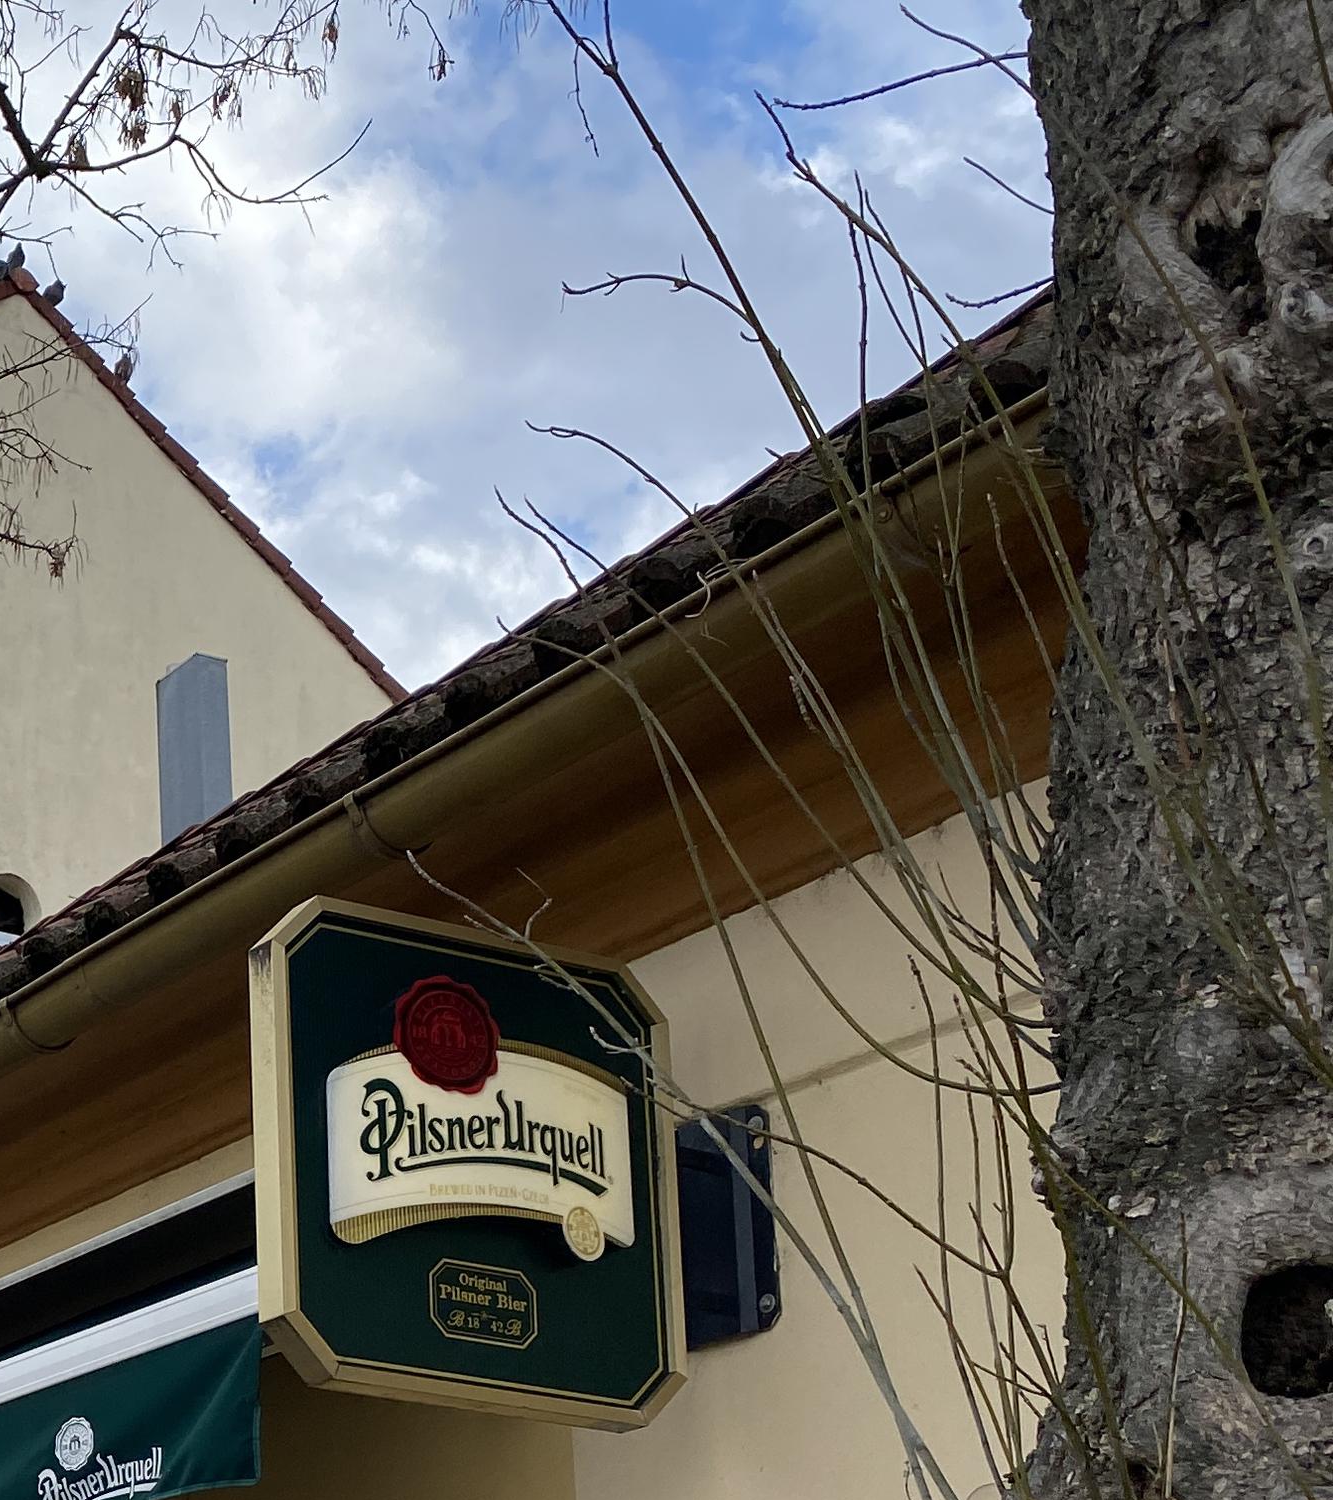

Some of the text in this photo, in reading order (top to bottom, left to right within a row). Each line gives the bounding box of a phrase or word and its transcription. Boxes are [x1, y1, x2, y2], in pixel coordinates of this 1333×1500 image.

[459, 1272, 508, 1293] Original
[438, 1283, 528, 1313] Pilsner Bier
[467, 1316, 480, 1329] 18
[490, 1320, 504, 1333] 42
